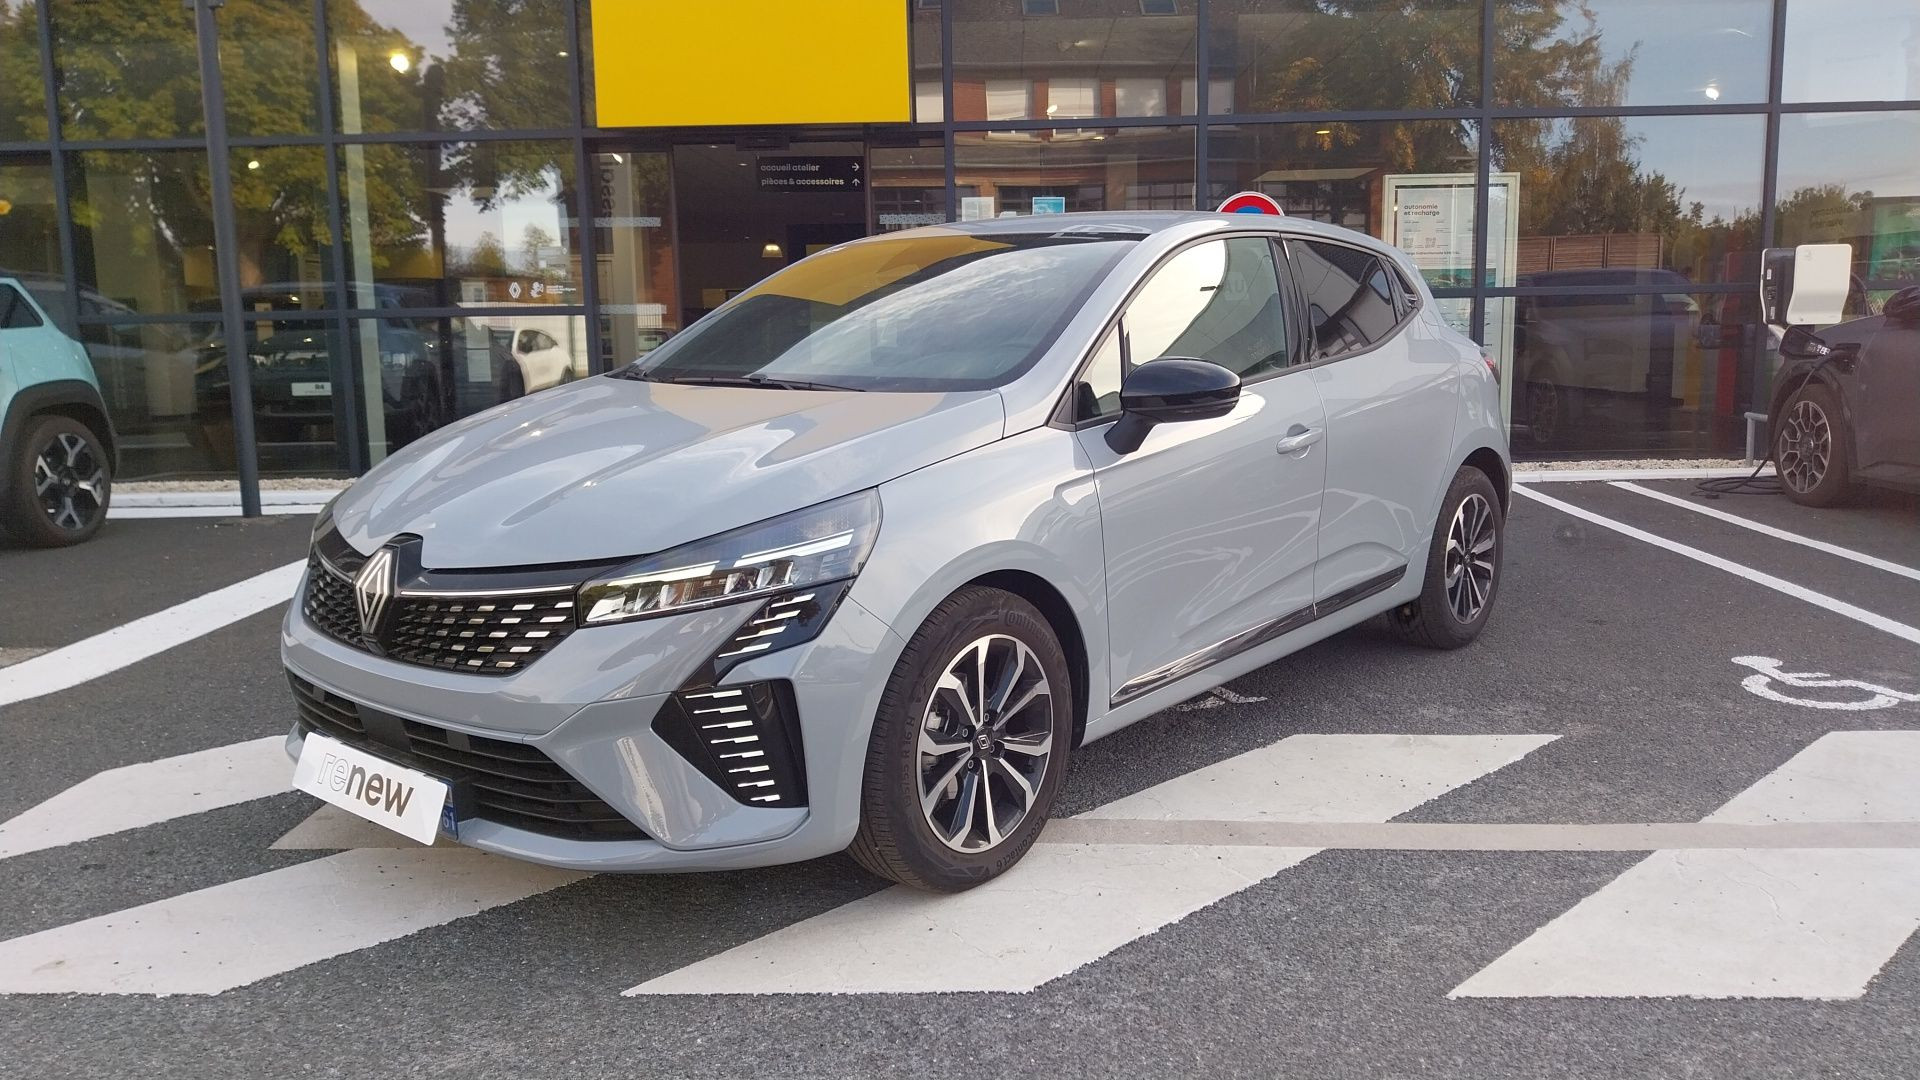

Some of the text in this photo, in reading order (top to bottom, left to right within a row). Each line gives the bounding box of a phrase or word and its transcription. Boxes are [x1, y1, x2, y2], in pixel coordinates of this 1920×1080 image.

[760, 163, 820, 171] accueil atelier
[761, 177, 788, 186] pièces
[796, 177, 844, 185] accessoires
[1411, 209, 1440, 217] recharge
[316, 752, 415, 818] renew
[442, 810, 455, 832] 61
